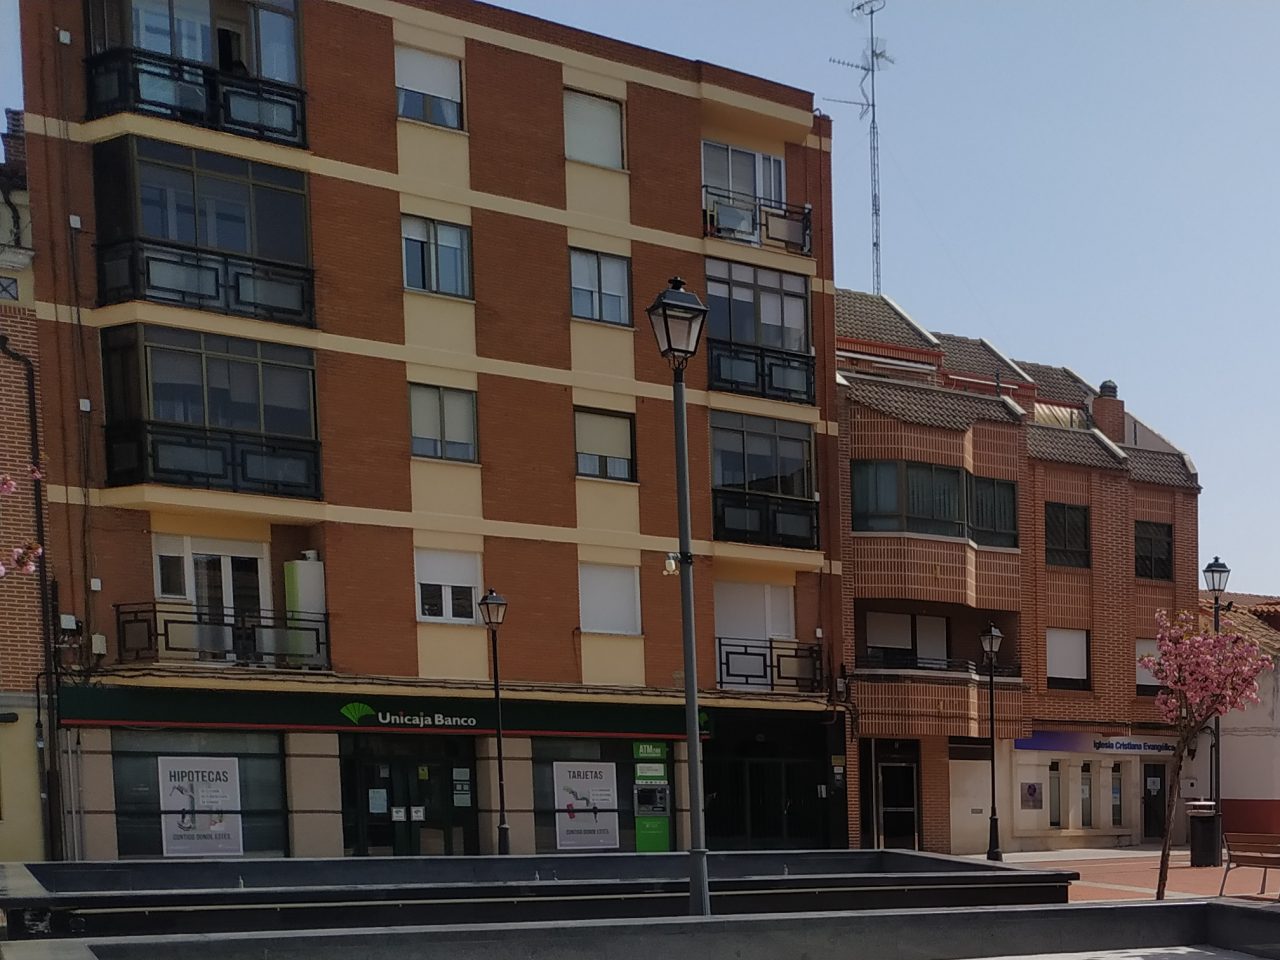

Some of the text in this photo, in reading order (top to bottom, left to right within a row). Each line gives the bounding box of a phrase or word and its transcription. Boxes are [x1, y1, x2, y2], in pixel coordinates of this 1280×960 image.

[378, 711, 477, 728] Unicaja Banco
[639, 744, 653, 754] ATM
[1093, 740, 1114, 750] Iglesia
[1115, 742, 1142, 750] Cristiana
[169, 770, 229, 783] HIPOTECAS
[567, 770, 604, 780] TARJETAS
